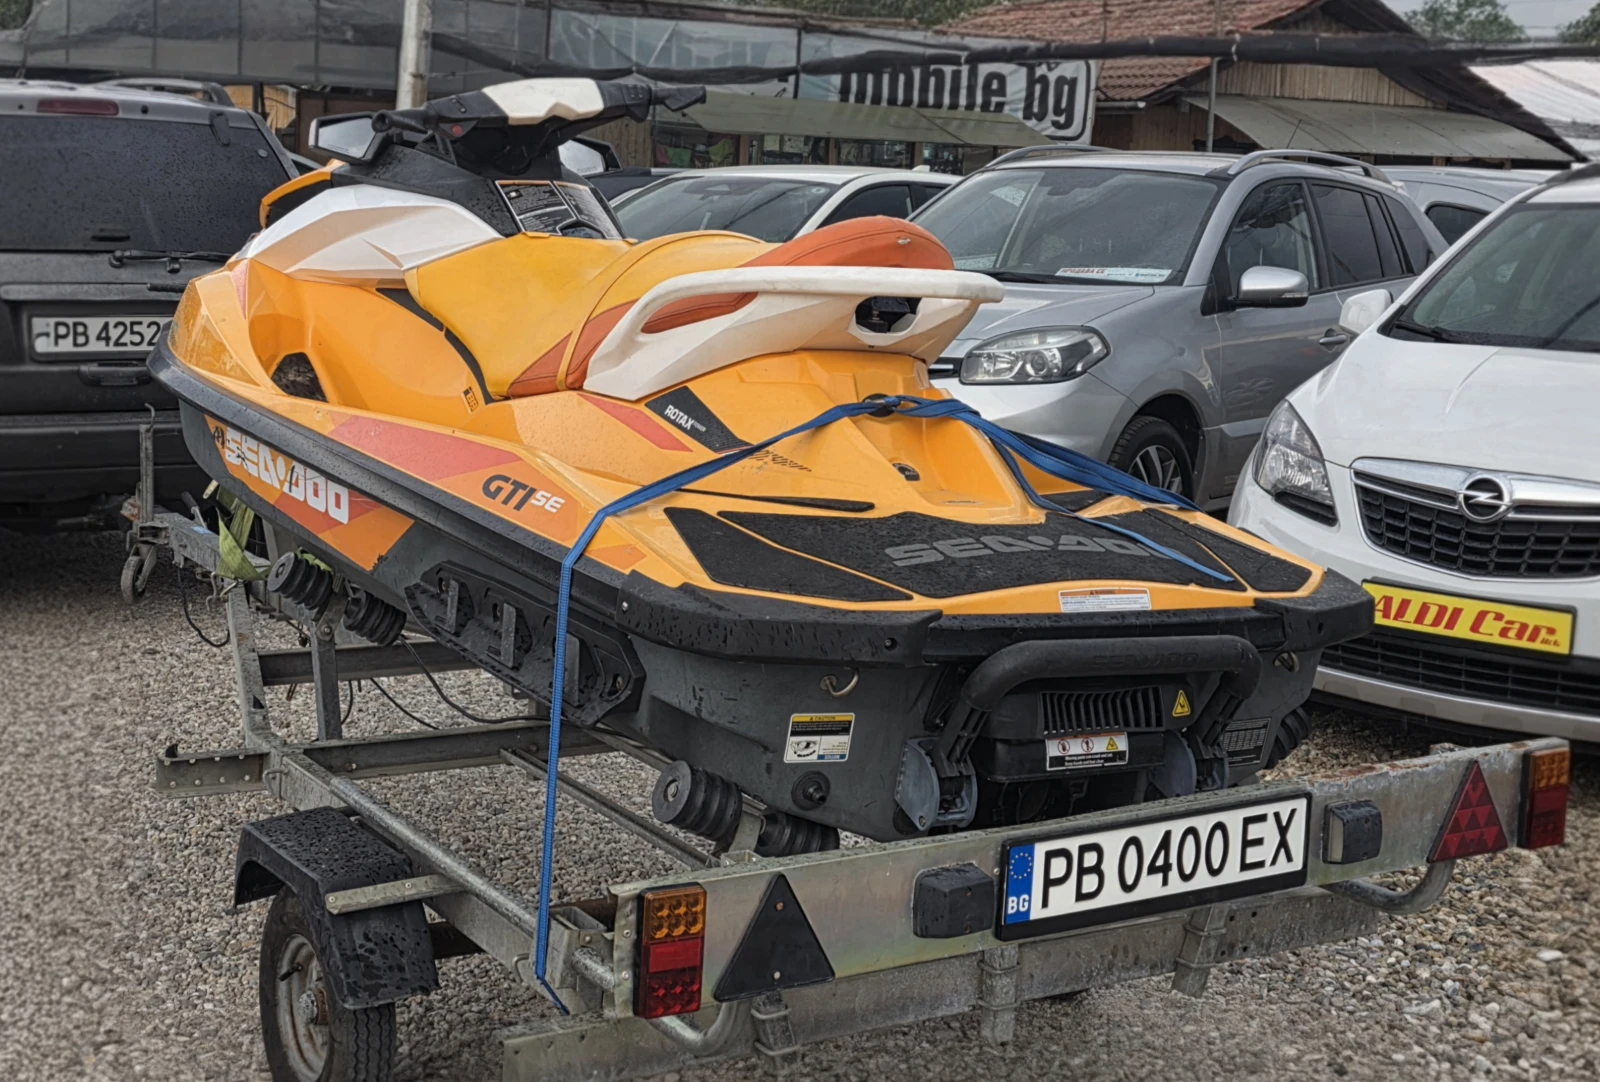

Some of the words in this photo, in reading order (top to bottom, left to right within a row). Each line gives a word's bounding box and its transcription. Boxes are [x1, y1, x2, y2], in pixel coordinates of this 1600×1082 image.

[53, 321, 90, 347] PB
[96, 321, 162, 347] 4252
[664, 404, 695, 430] ROTAX
[482, 473, 537, 512] GTI
[530, 490, 566, 513] SE
[1375, 594, 1464, 630] ALDI
[1469, 609, 1557, 643] Car
[1041, 842, 1105, 909] PB
[1118, 820, 1230, 894] 0400
[1239, 807, 1298, 873] EX
[1007, 894, 1029, 914] BG
